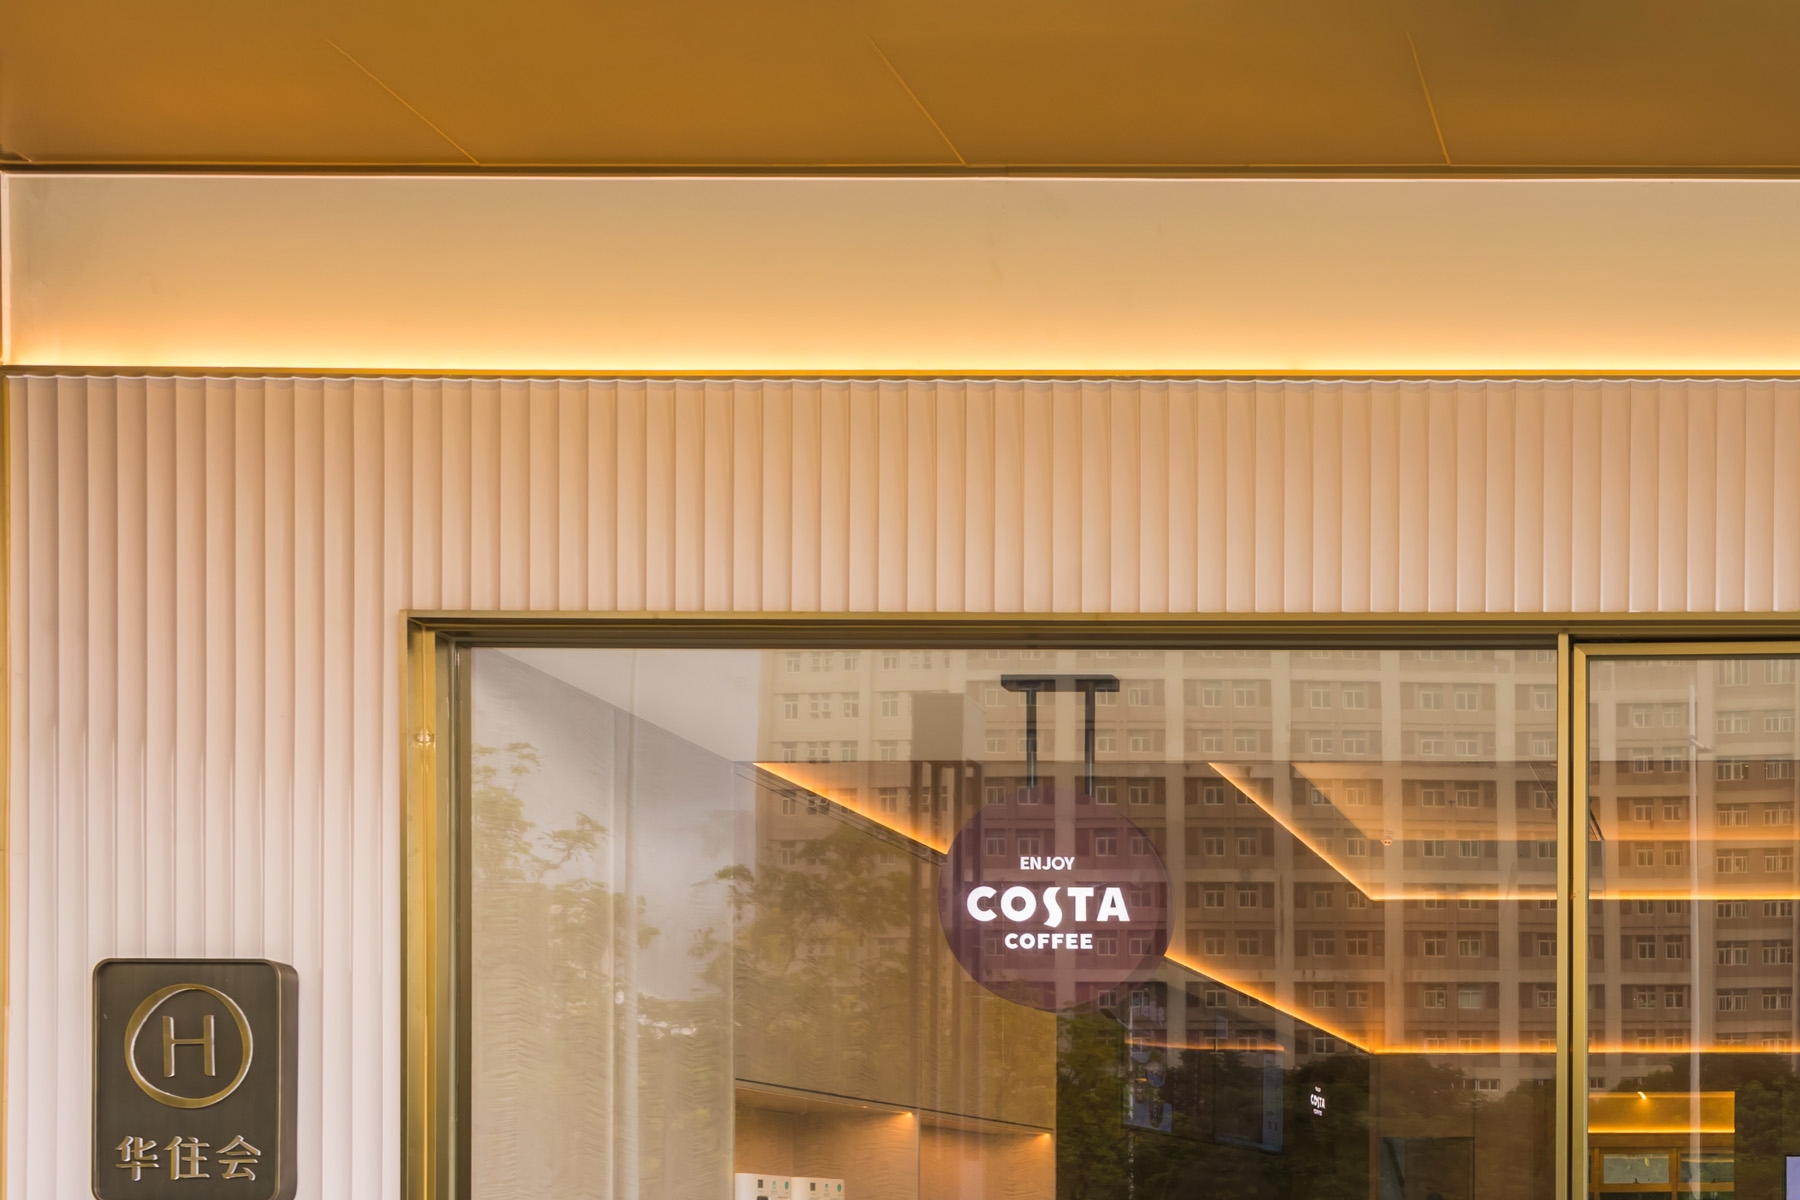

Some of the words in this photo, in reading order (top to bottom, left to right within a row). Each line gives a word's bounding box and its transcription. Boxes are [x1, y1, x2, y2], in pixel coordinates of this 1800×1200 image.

[1020, 857, 1075, 870] ENJOY
[967, 885, 1130, 928] COSTA
[1004, 933, 1093, 949] COFFEE
[115, 1134, 262, 1181] 华住会
